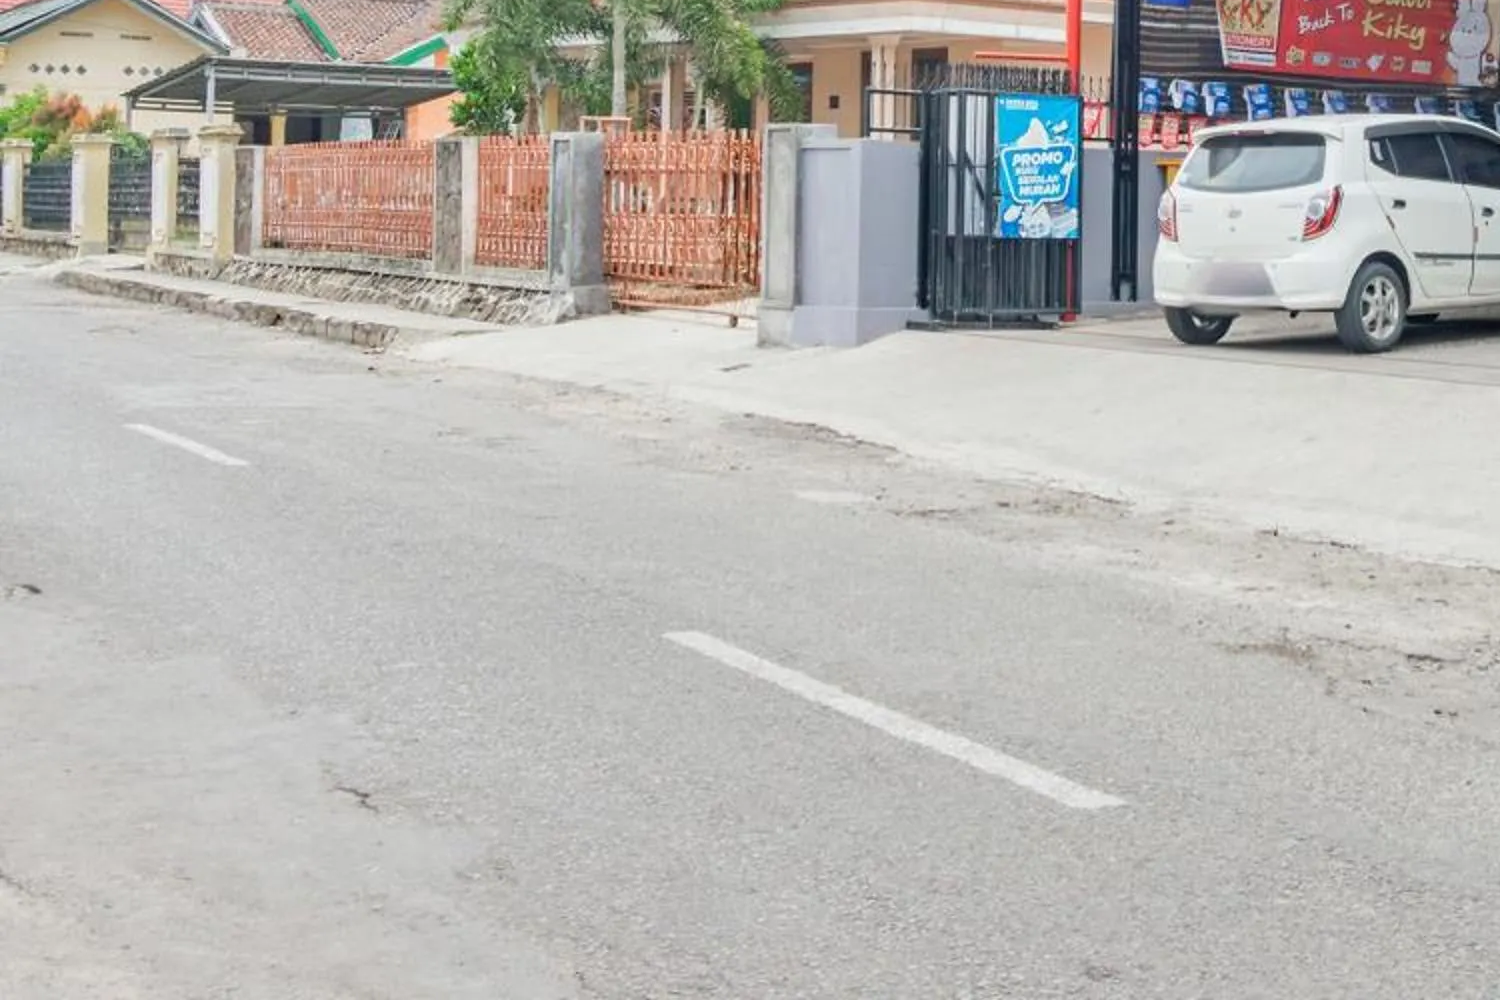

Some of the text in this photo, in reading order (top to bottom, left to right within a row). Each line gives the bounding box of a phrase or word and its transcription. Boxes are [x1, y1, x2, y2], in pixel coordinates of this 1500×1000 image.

[1299, 4, 1426, 50] Back To Kiky
[1012, 151, 1063, 166] PROMO
